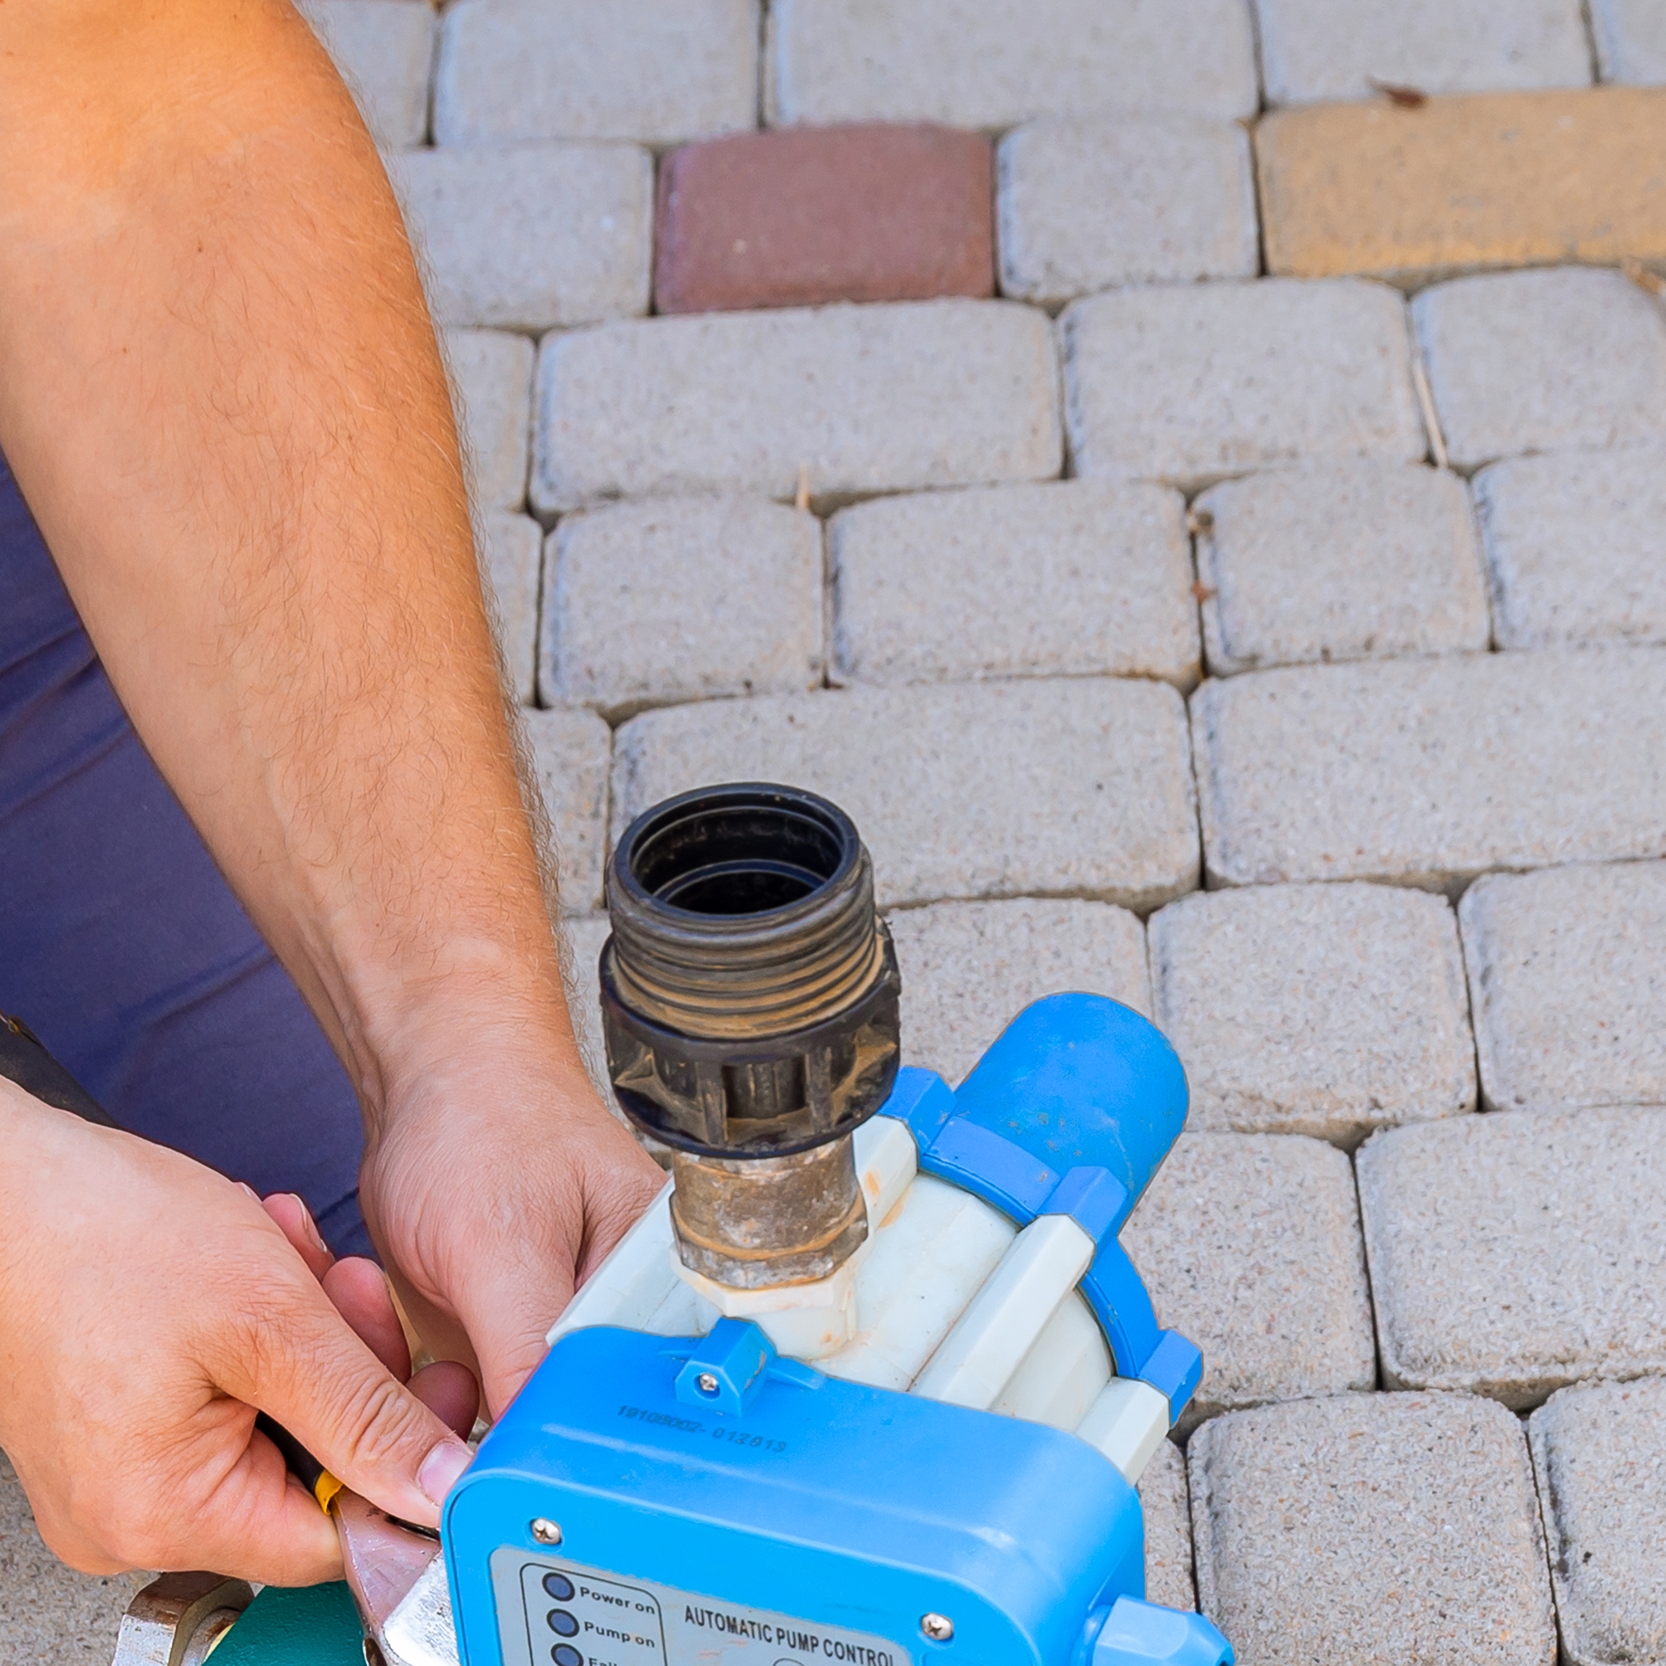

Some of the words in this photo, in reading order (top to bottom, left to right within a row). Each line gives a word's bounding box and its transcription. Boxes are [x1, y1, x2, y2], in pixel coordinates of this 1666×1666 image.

[579, 1586, 630, 1608] Power
[635, 1602, 655, 1615] on
[584, 1621, 631, 1643] Pump
[635, 1636, 655, 1648] on
[684, 1605, 772, 1643] AUTOMATIC
[776, 1627, 819, 1653] PUMP
